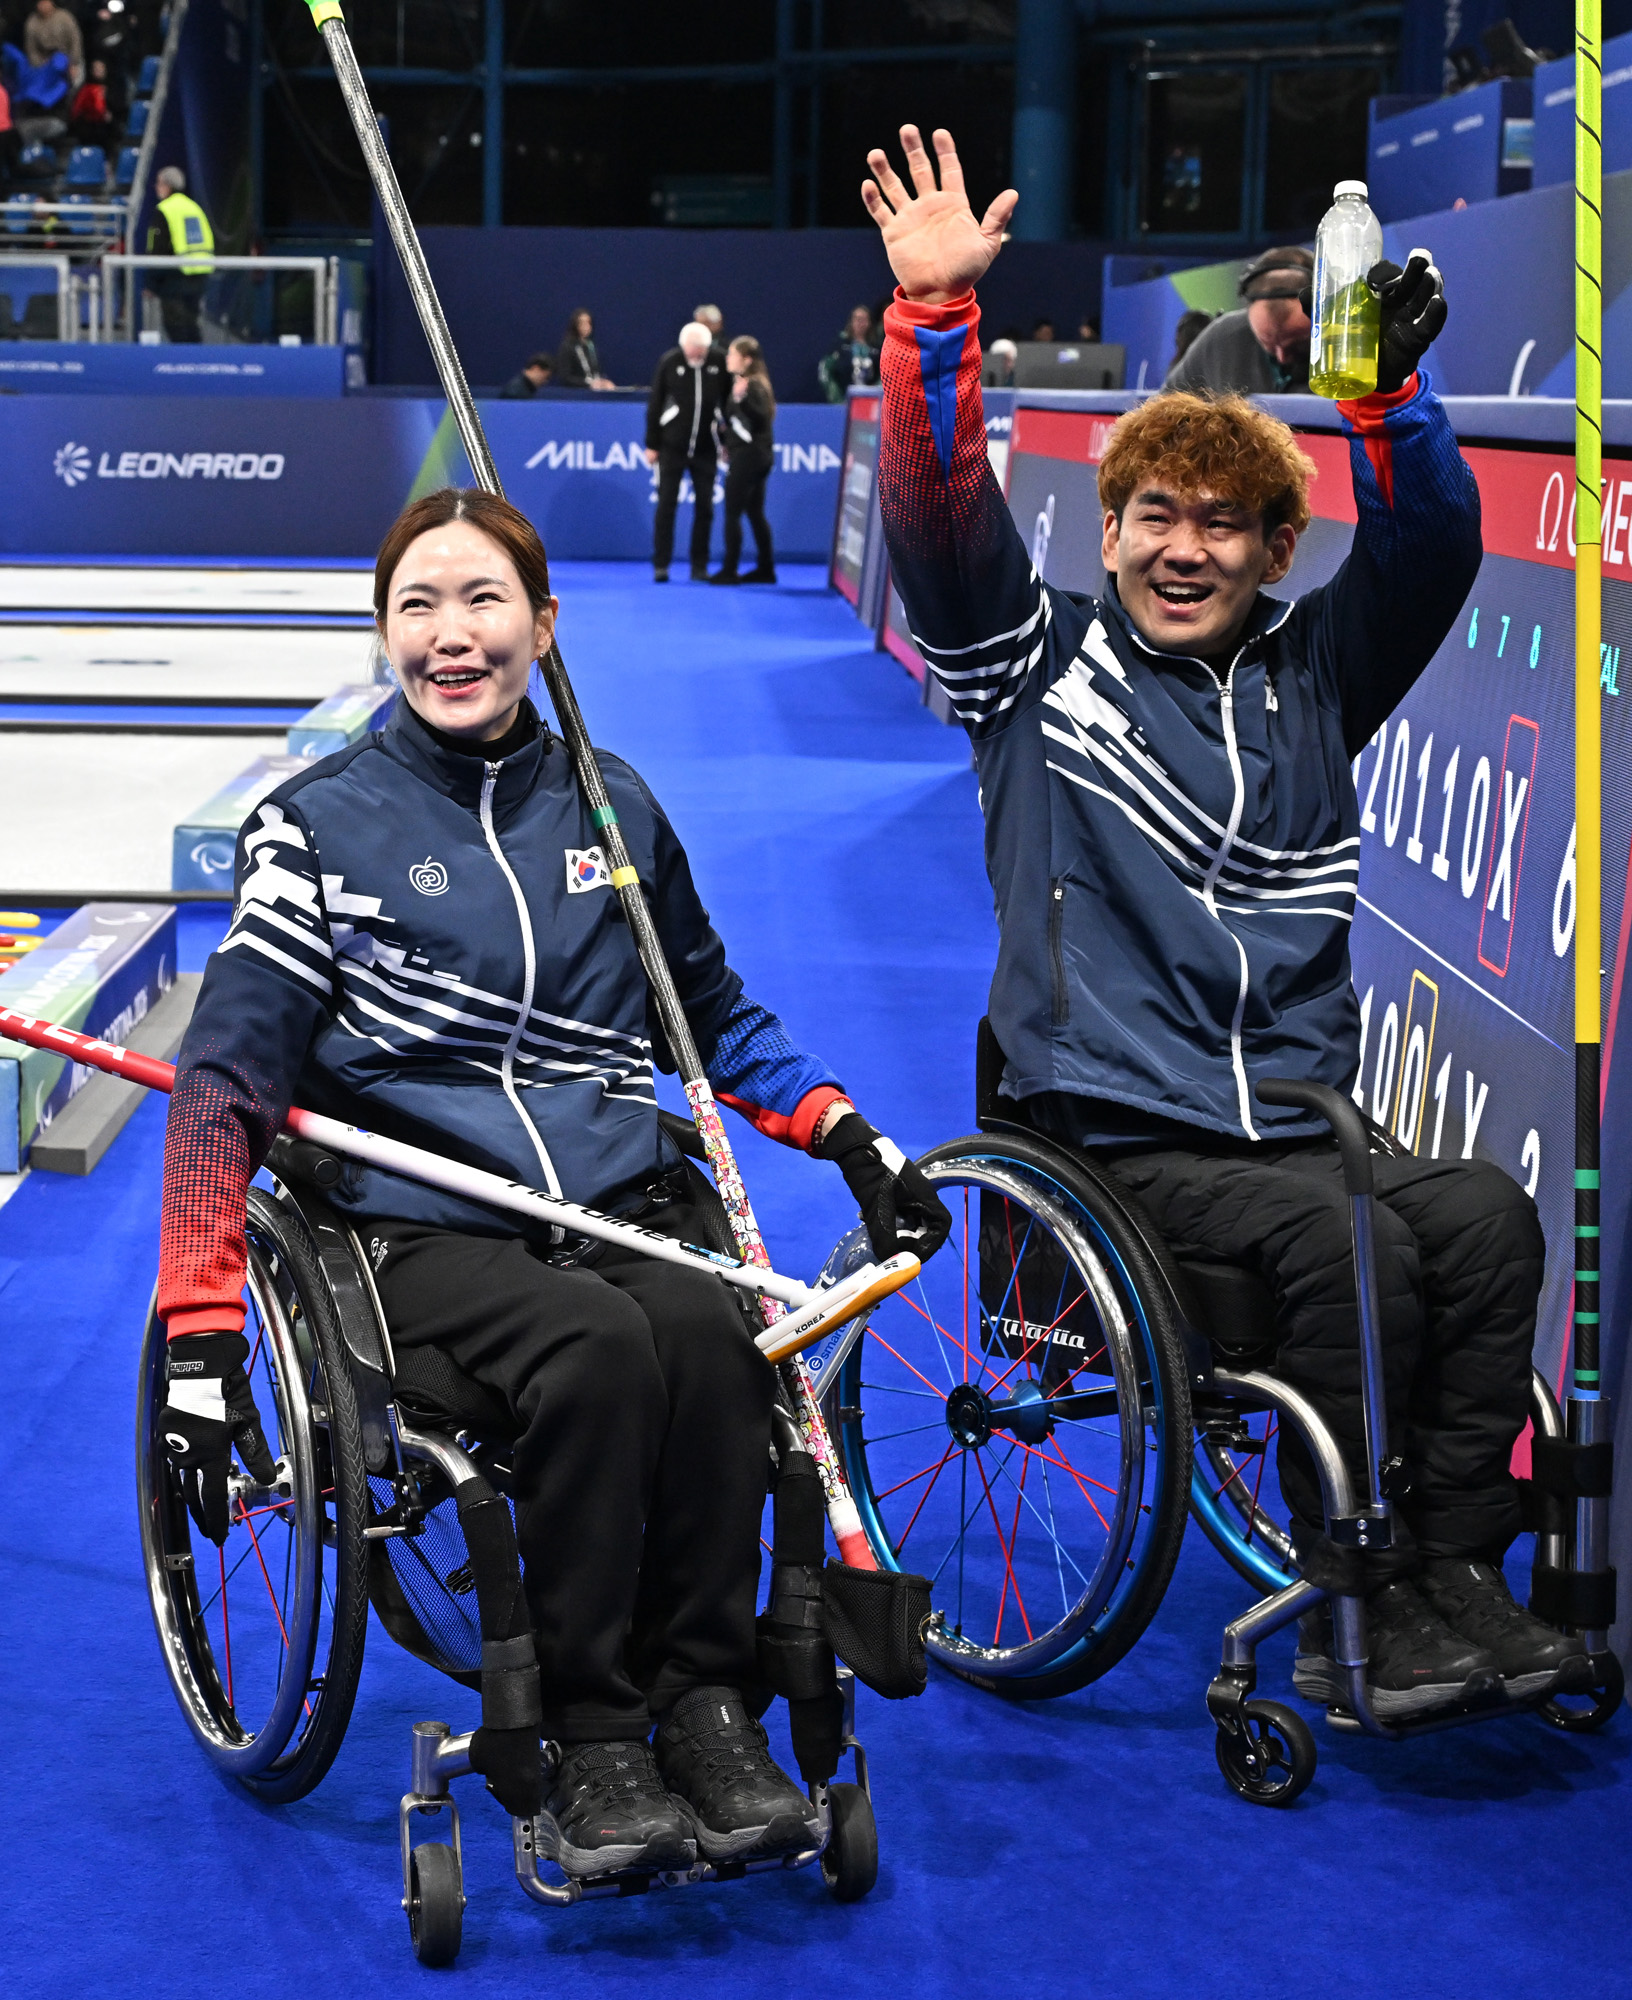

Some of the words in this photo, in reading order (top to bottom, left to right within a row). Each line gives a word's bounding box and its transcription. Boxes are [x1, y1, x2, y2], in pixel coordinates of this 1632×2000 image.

[98, 452, 285, 480] LEONARDO
[525, 441, 653, 470] MILAN
[1468, 607, 1479, 648] 6
[1498, 615, 1510, 658] 7
[1530, 625, 1542, 669] 8
[795, 1313, 826, 1335] KOREA
